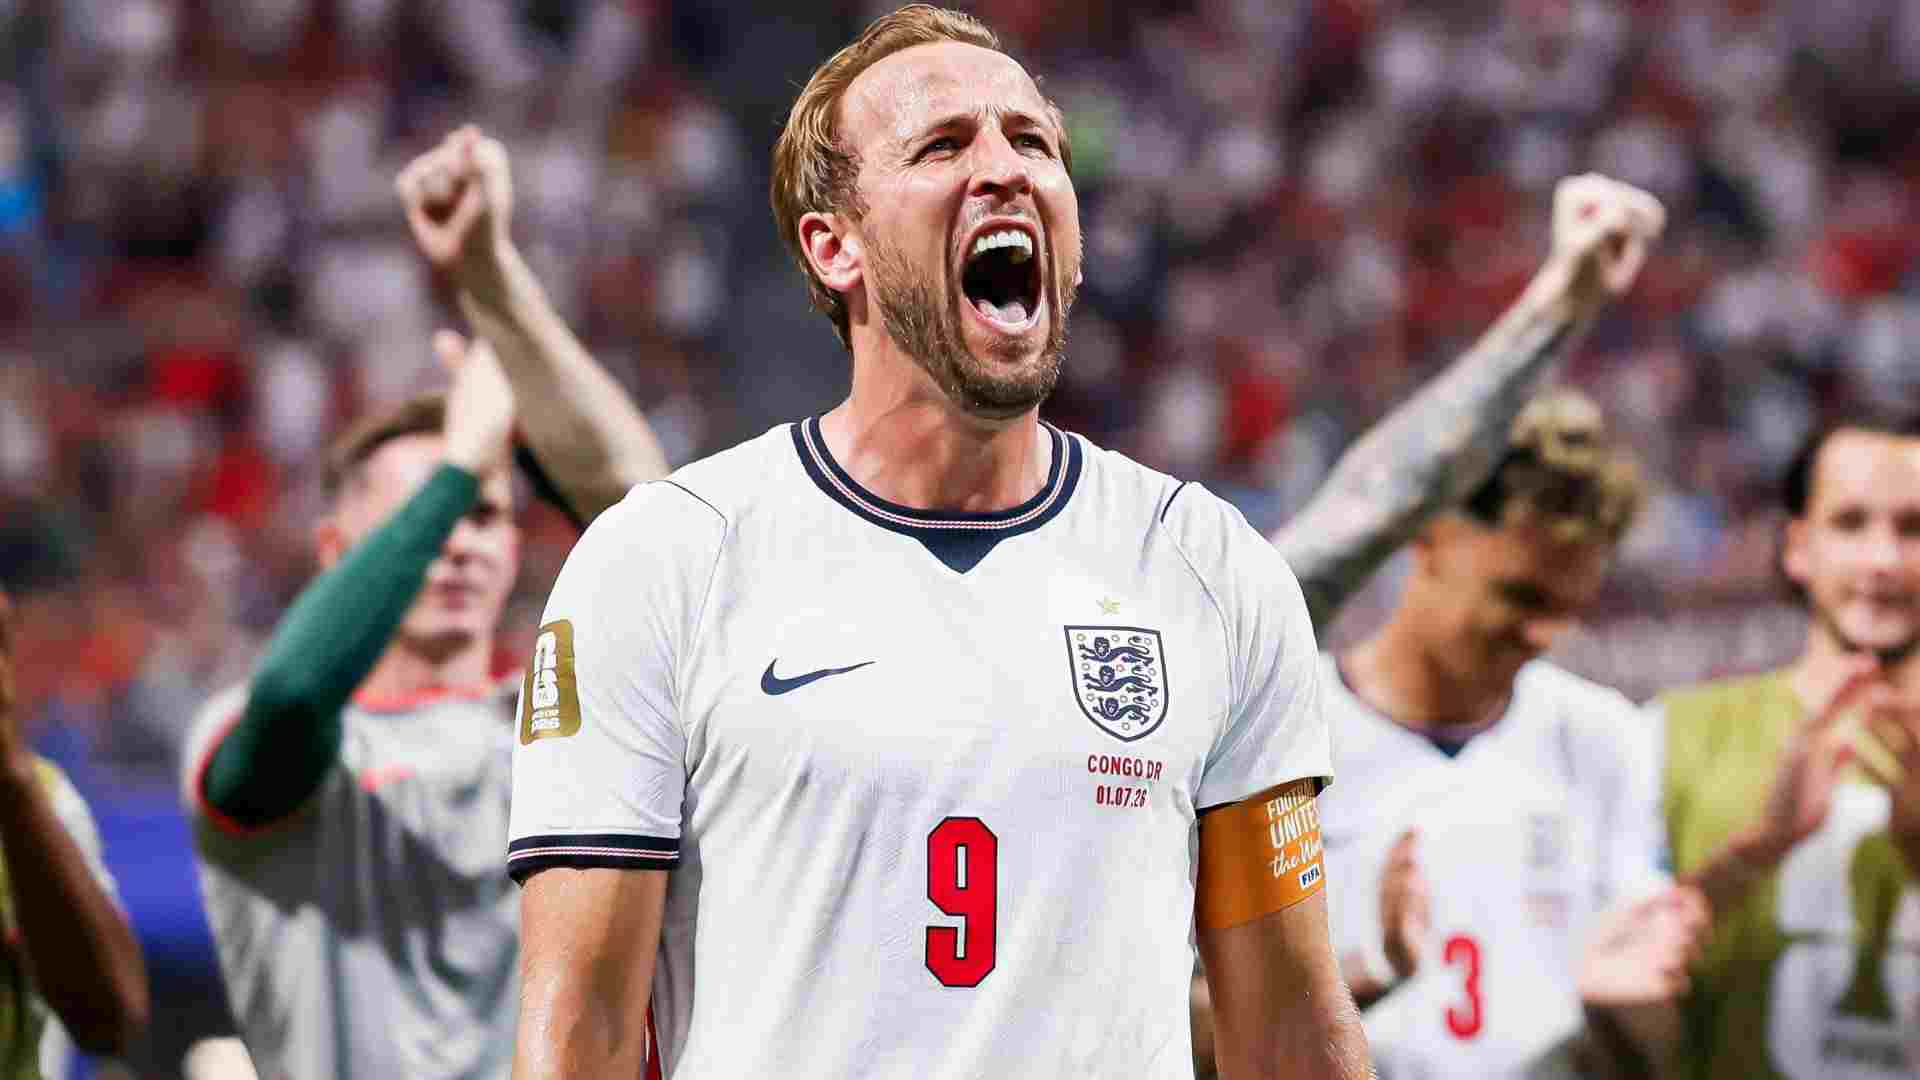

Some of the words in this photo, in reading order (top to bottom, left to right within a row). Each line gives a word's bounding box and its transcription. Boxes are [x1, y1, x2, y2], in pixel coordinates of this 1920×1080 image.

[1088, 754, 1143, 777] CONGO
[1146, 759, 1162, 781] DR
[1096, 784, 1148, 808] 01.07.26
[925, 816, 998, 988] 9
[1442, 931, 1484, 1040] 3
